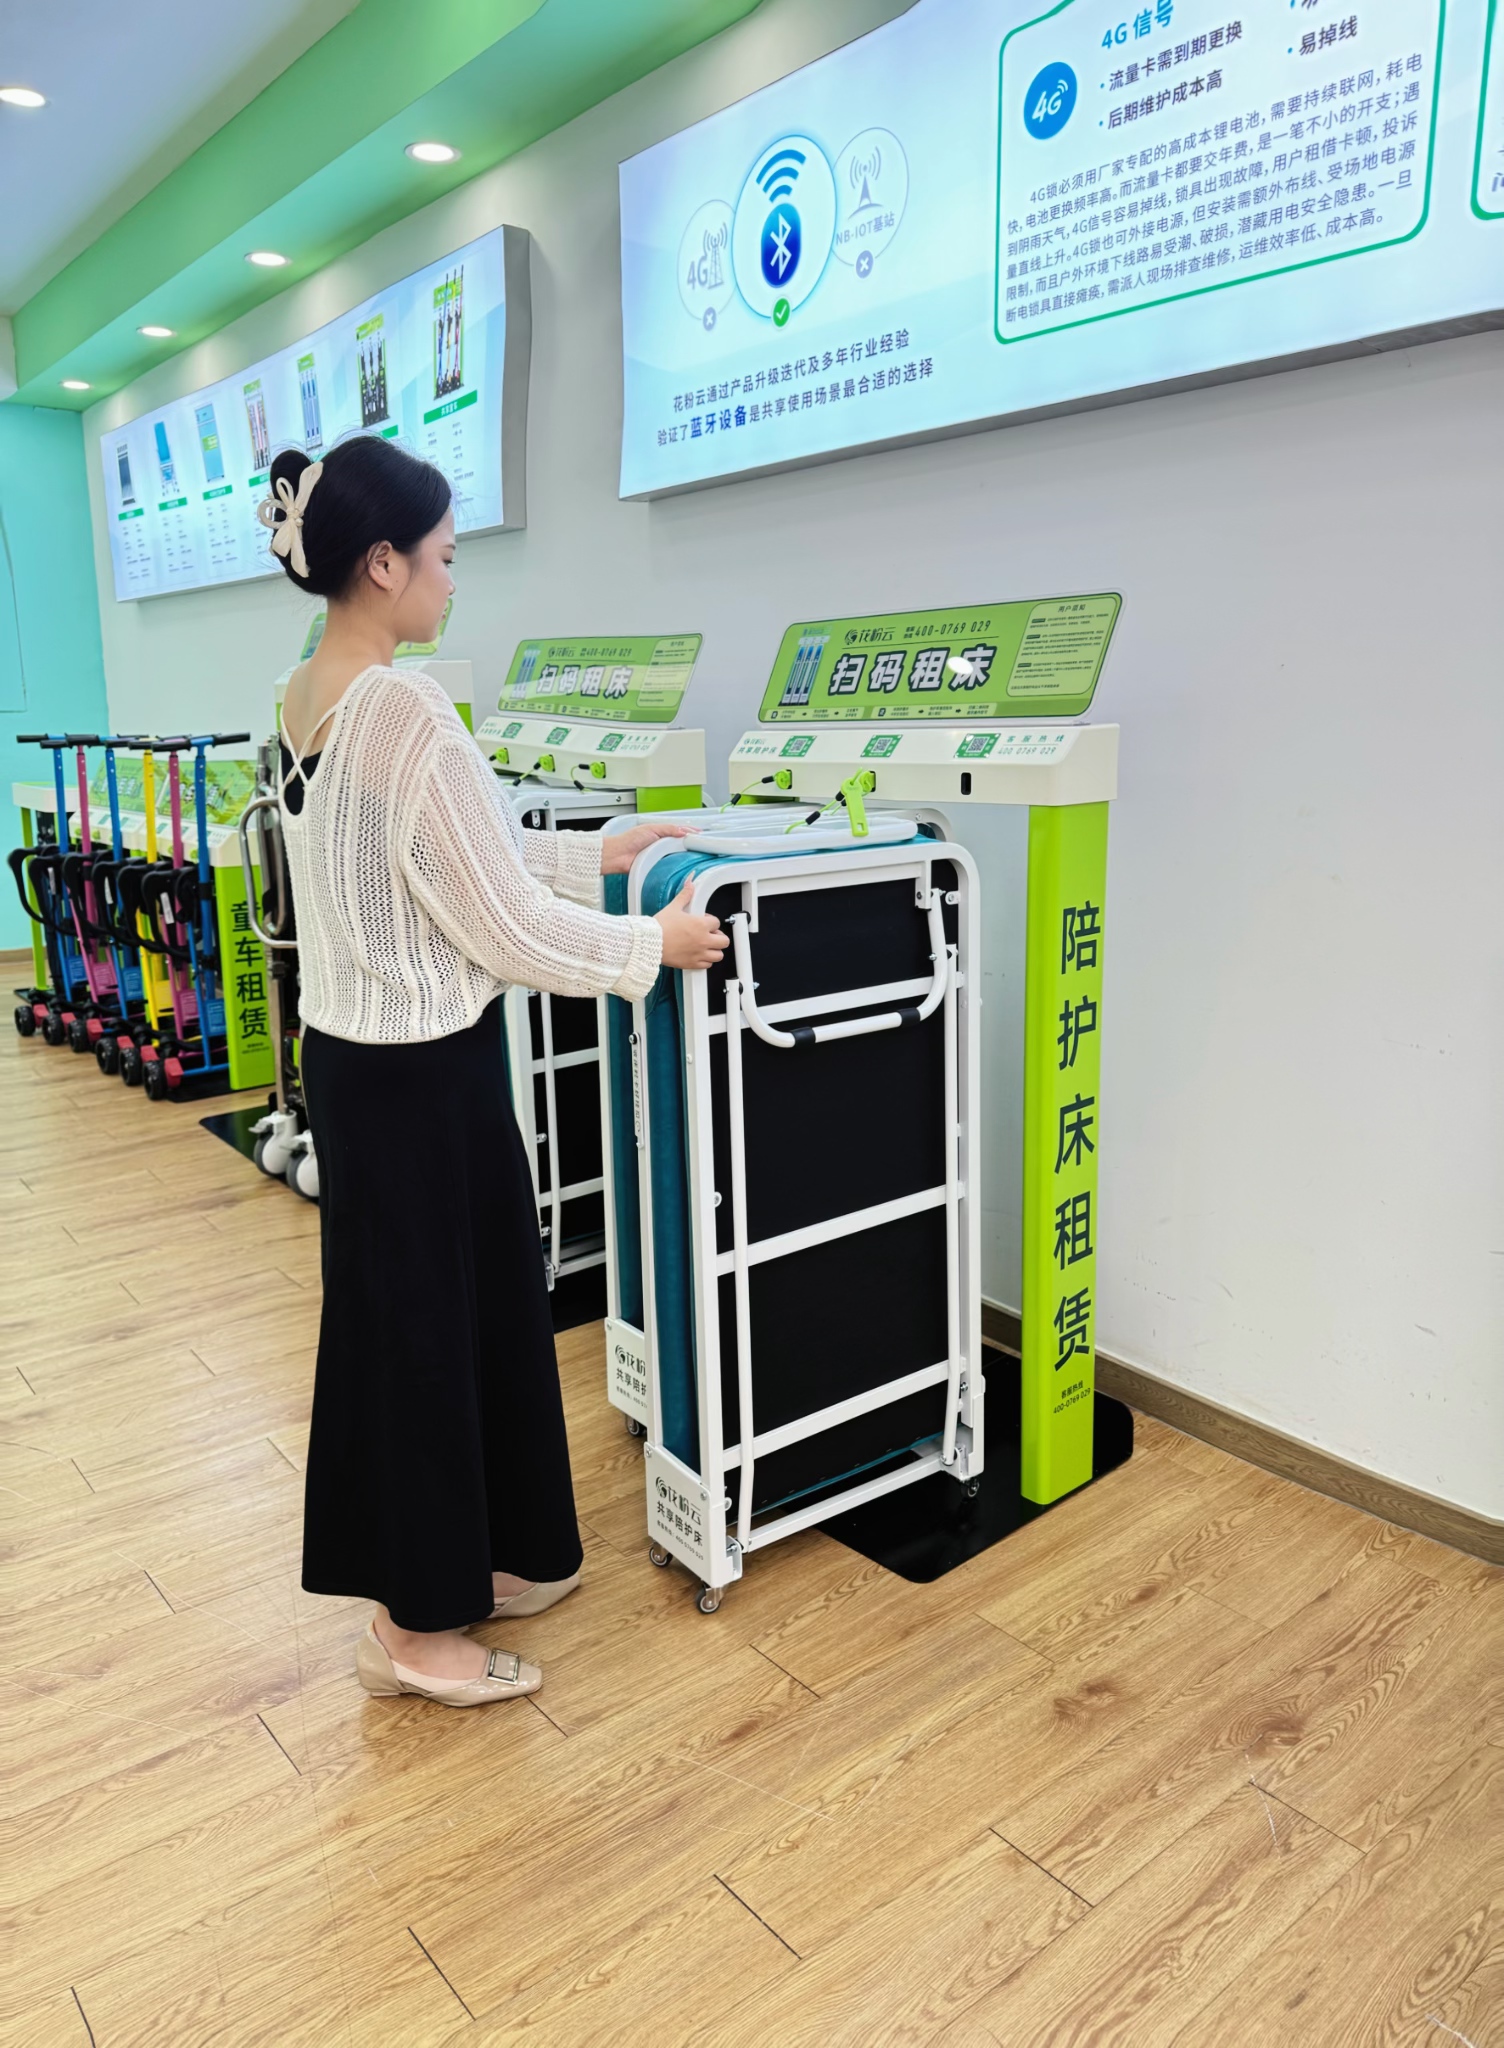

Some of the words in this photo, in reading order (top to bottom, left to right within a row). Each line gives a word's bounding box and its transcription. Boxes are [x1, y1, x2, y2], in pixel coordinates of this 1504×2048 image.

[1101, 22, 1127, 49] 4G
[1133, 0, 1173, 40] 信号
[1299, 15, 1358, 56] 易掉线
[1109, 20, 1243, 92] 流量卡需到期更换
[1032, 90, 1062, 123] 4G
[1107, 69, 1223, 130] 后期维护成本高
[835, 211, 895, 246] NB-IOT基站
[687, 251, 709, 290] 4G
[673, 328, 910, 413] 花粉云通过产品升级迭代及多年行业经验
[657, 357, 934, 447] 验证了蓝牙设备是共享使用场景最合适的选择
[859, 626, 896, 643] 花粉云
[970, 620, 991, 633] 029
[535, 663, 634, 699] 扫码租床
[828, 643, 997, 696] 扫码租床
[230, 900, 268, 1039] 童车租赁
[1053, 899, 1101, 1372] 陪护床租赁
[657, 1500, 703, 1547] 共享陪护床
[667, 1485, 702, 1526] 花粉云
